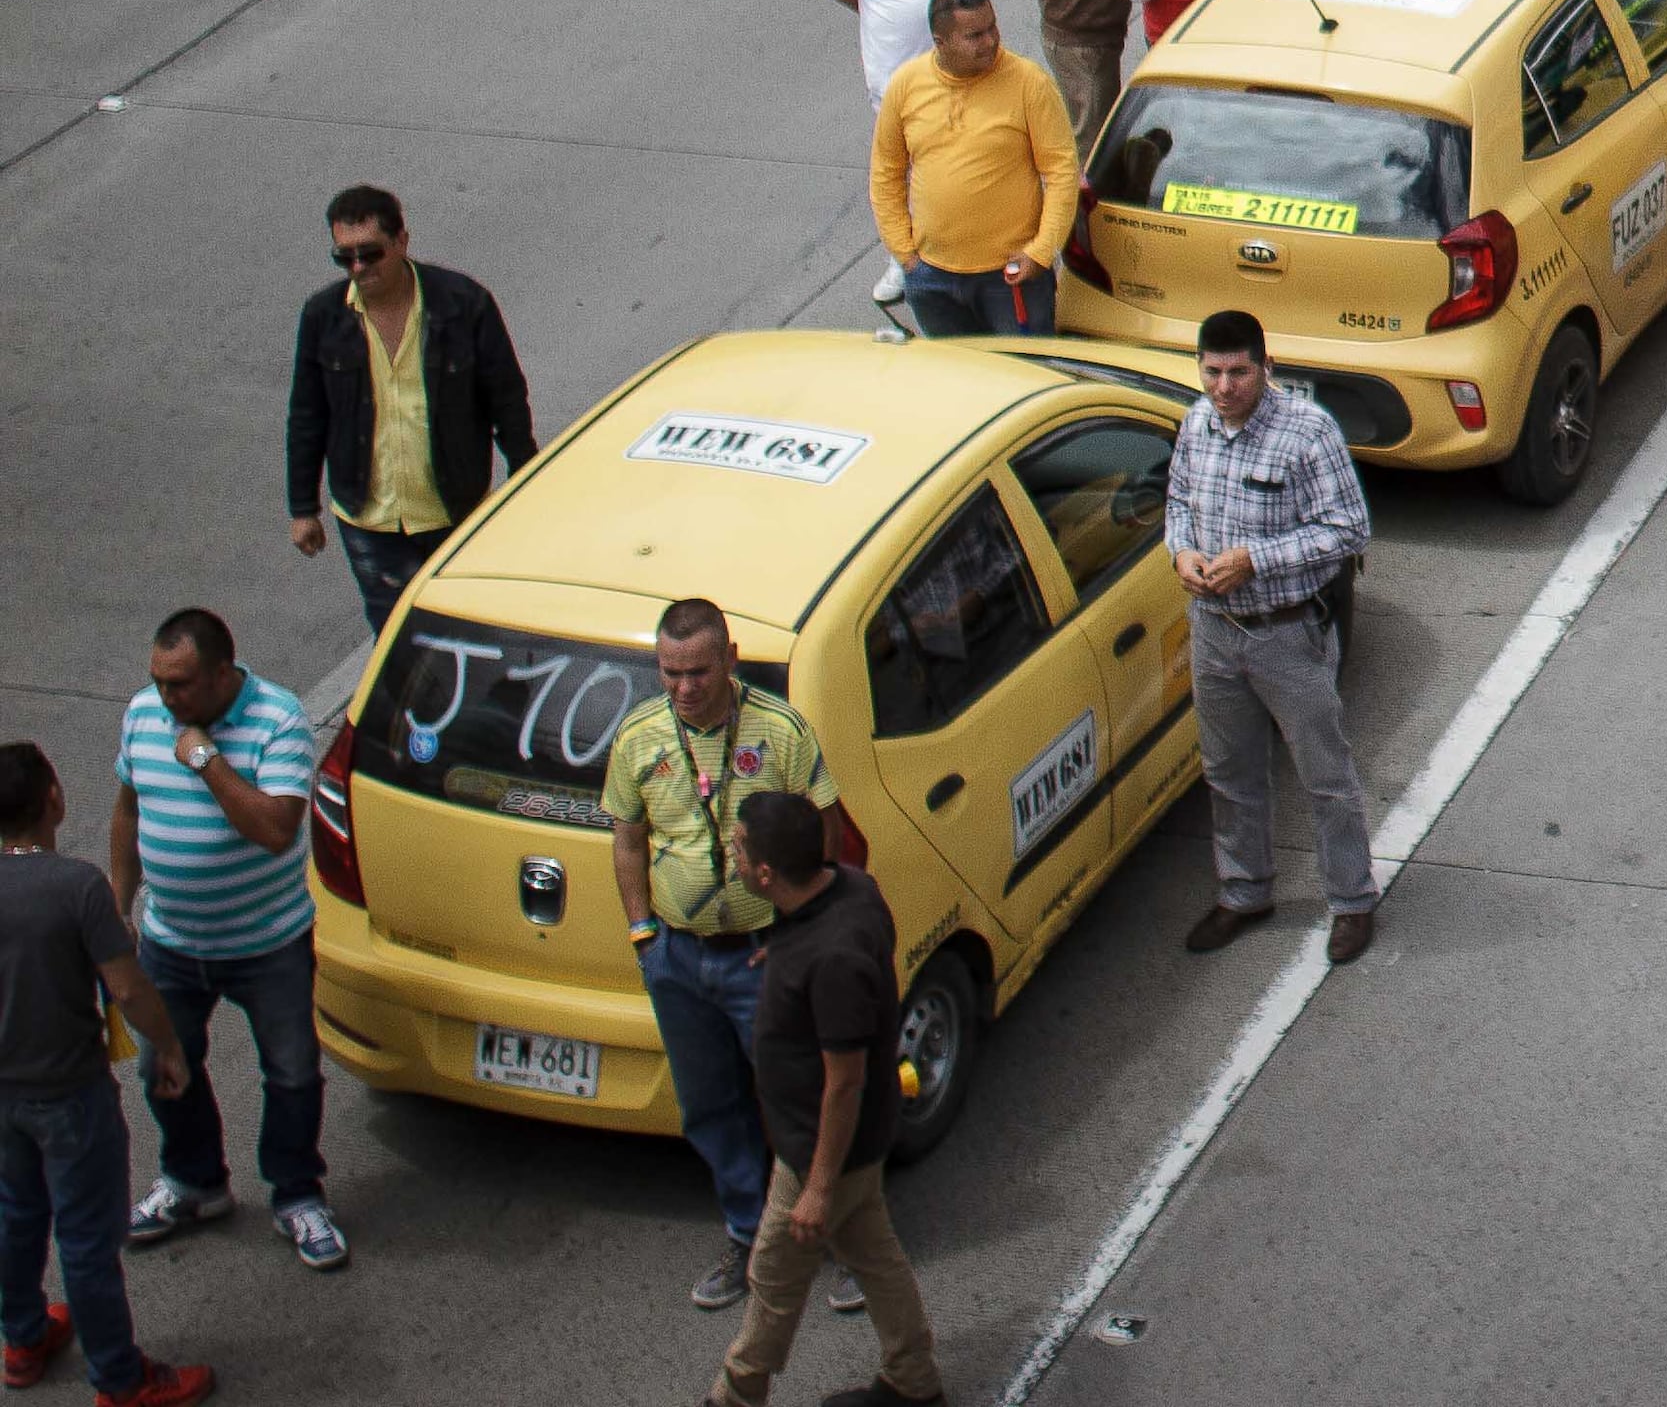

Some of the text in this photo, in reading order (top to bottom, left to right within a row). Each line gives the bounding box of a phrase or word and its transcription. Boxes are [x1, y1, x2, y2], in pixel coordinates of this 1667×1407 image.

[1338, 312, 1386, 330] 45424
[657, 426, 841, 467] WEW 681
[482, 1030, 590, 1079] WEW 681
